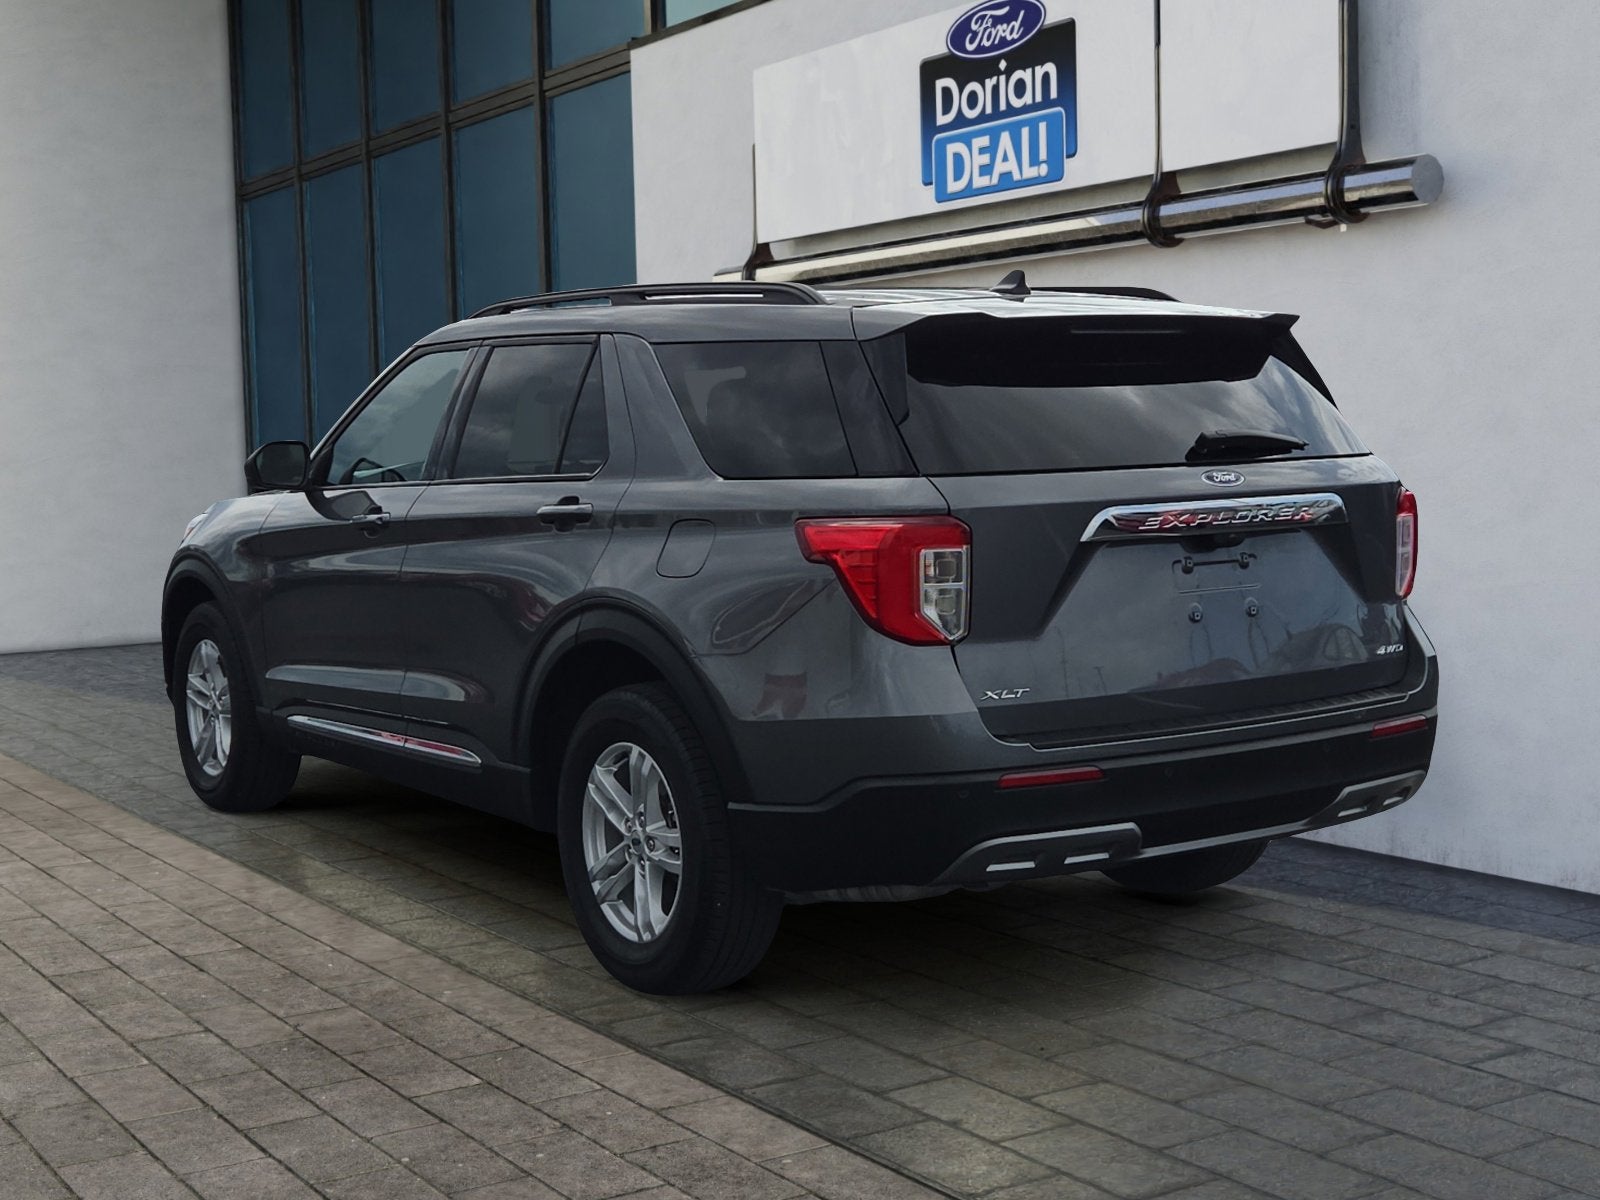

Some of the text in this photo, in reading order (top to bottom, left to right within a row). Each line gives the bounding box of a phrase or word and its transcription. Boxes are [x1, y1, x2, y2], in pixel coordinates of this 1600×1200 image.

[965, 6, 1025, 51] Ford
[935, 58, 1058, 127] Dorian
[946, 121, 1049, 194] DEAL!
[1138, 506, 1314, 530] EXPLORER
[1376, 643, 1404, 655] 4WD
[980, 688, 1030, 700] XLT
